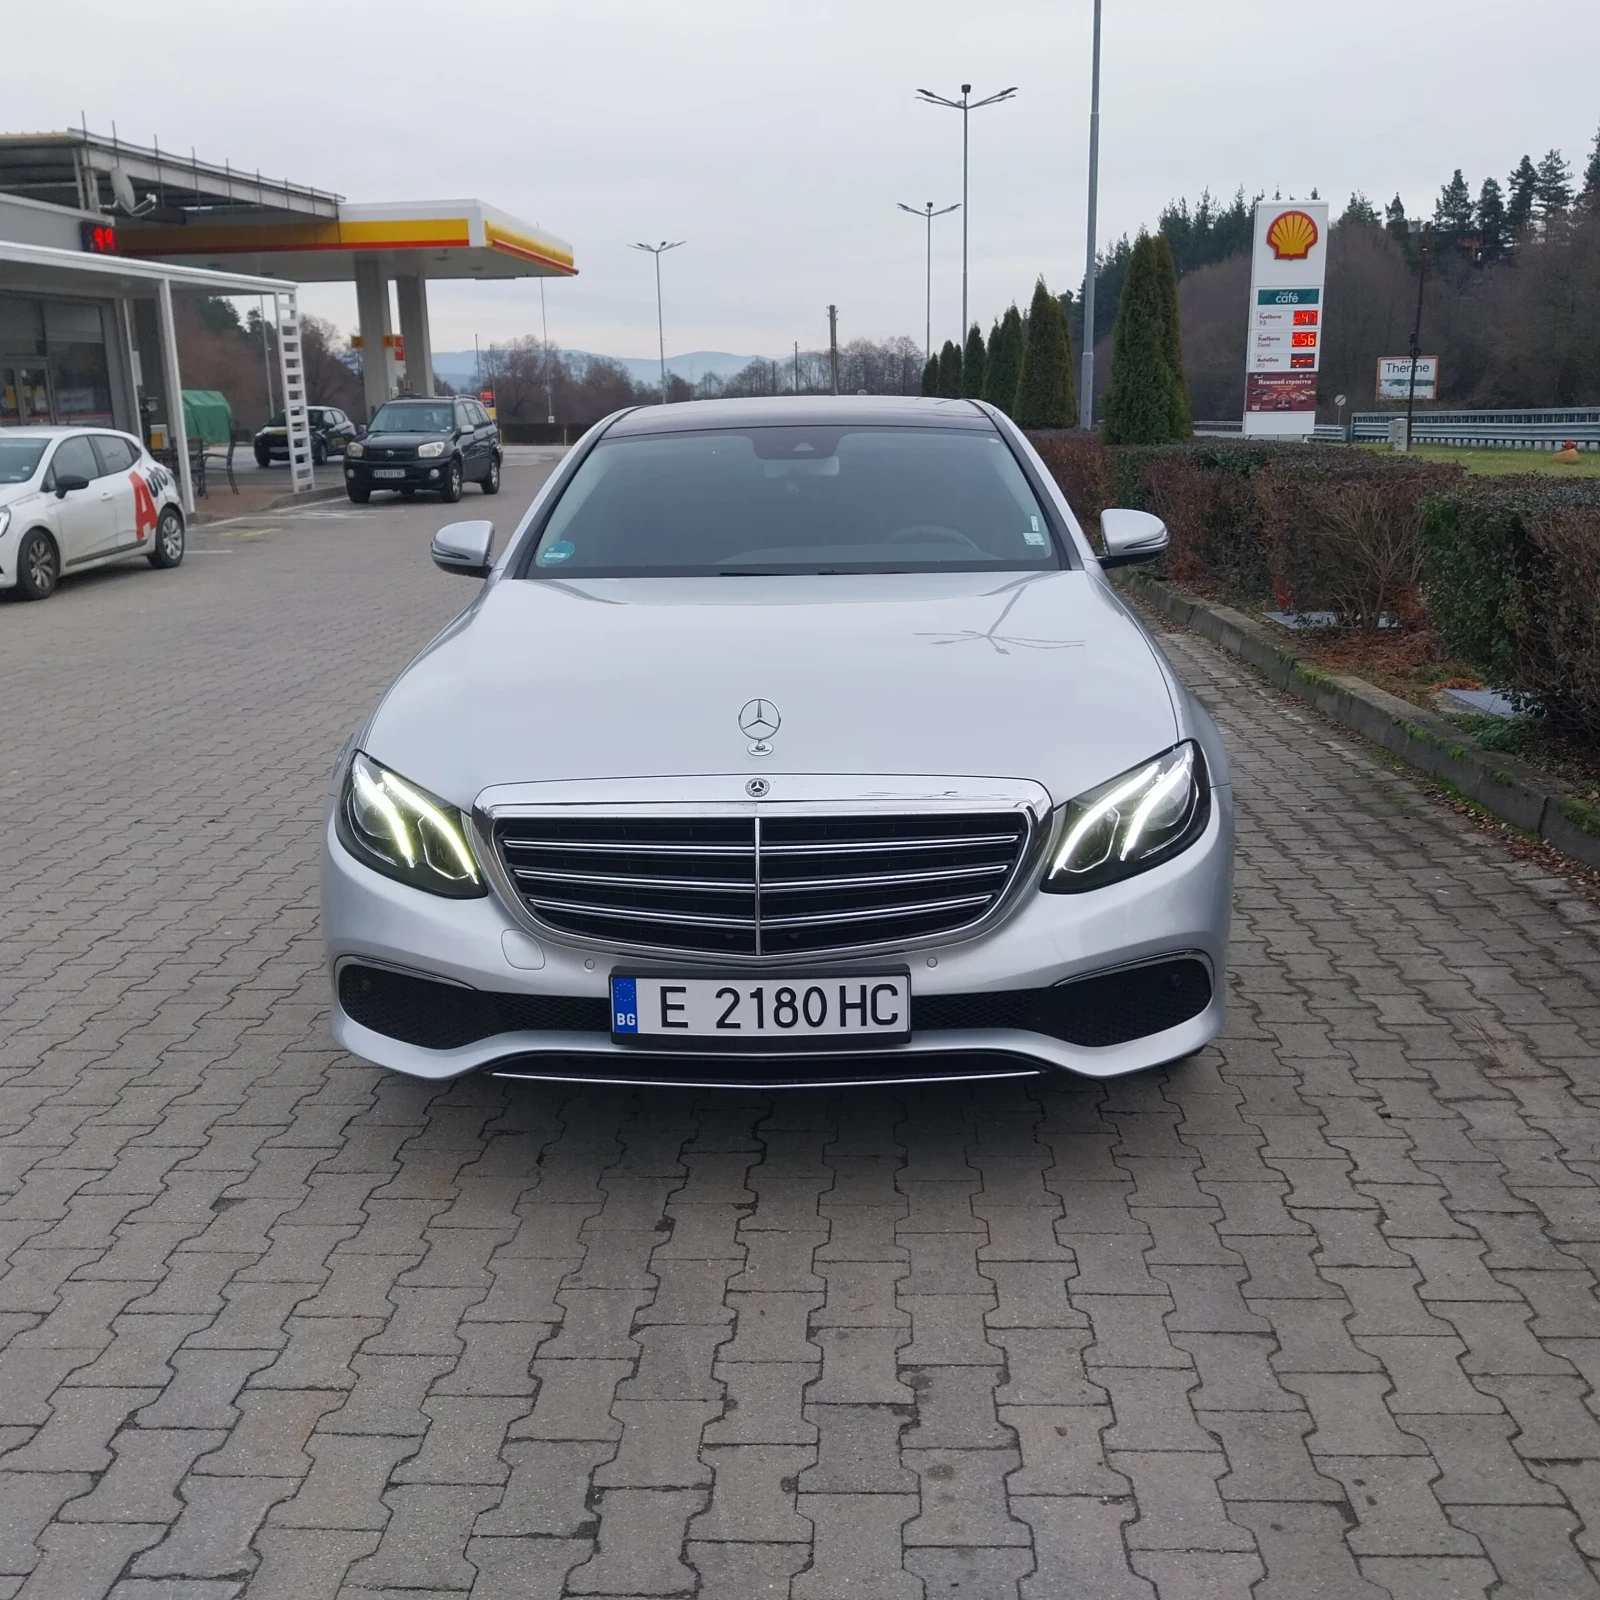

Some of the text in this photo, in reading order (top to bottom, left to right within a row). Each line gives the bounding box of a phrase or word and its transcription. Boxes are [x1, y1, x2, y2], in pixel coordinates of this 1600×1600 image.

[1275, 292, 1299, 304] café
[660, 983, 899, 1029] E 2180 HC
[617, 1013, 636, 1026] BG
